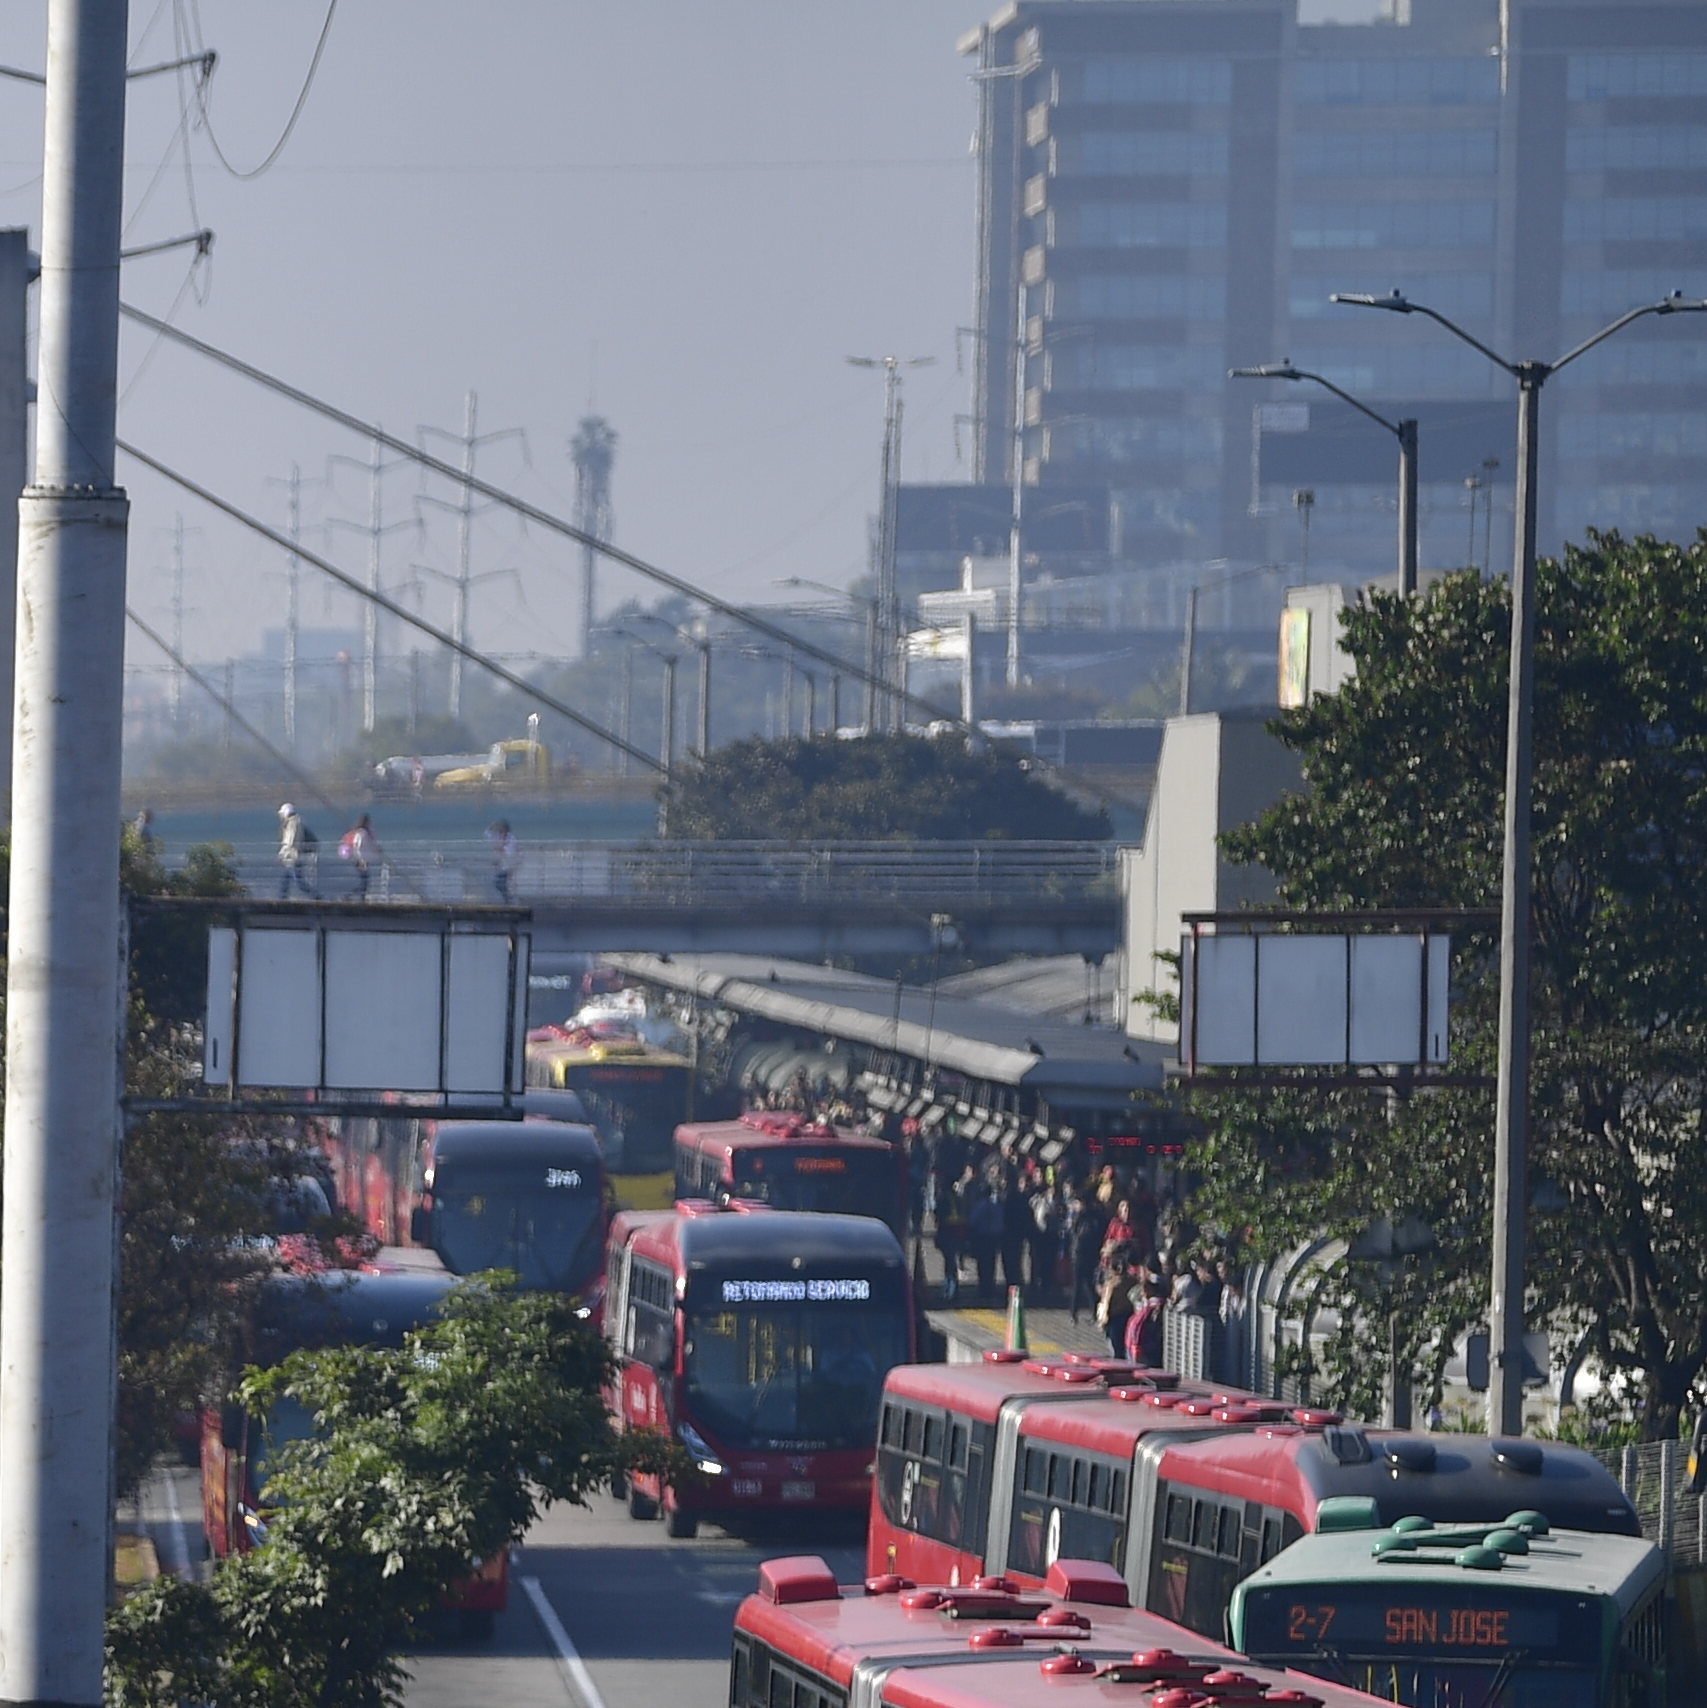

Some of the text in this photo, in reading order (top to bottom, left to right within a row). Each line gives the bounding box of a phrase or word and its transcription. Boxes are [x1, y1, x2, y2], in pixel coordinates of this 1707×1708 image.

[807, 1279, 871, 1301] SERVICIO
[1290, 1605, 1509, 1646] 2-7 SAN JOSE
